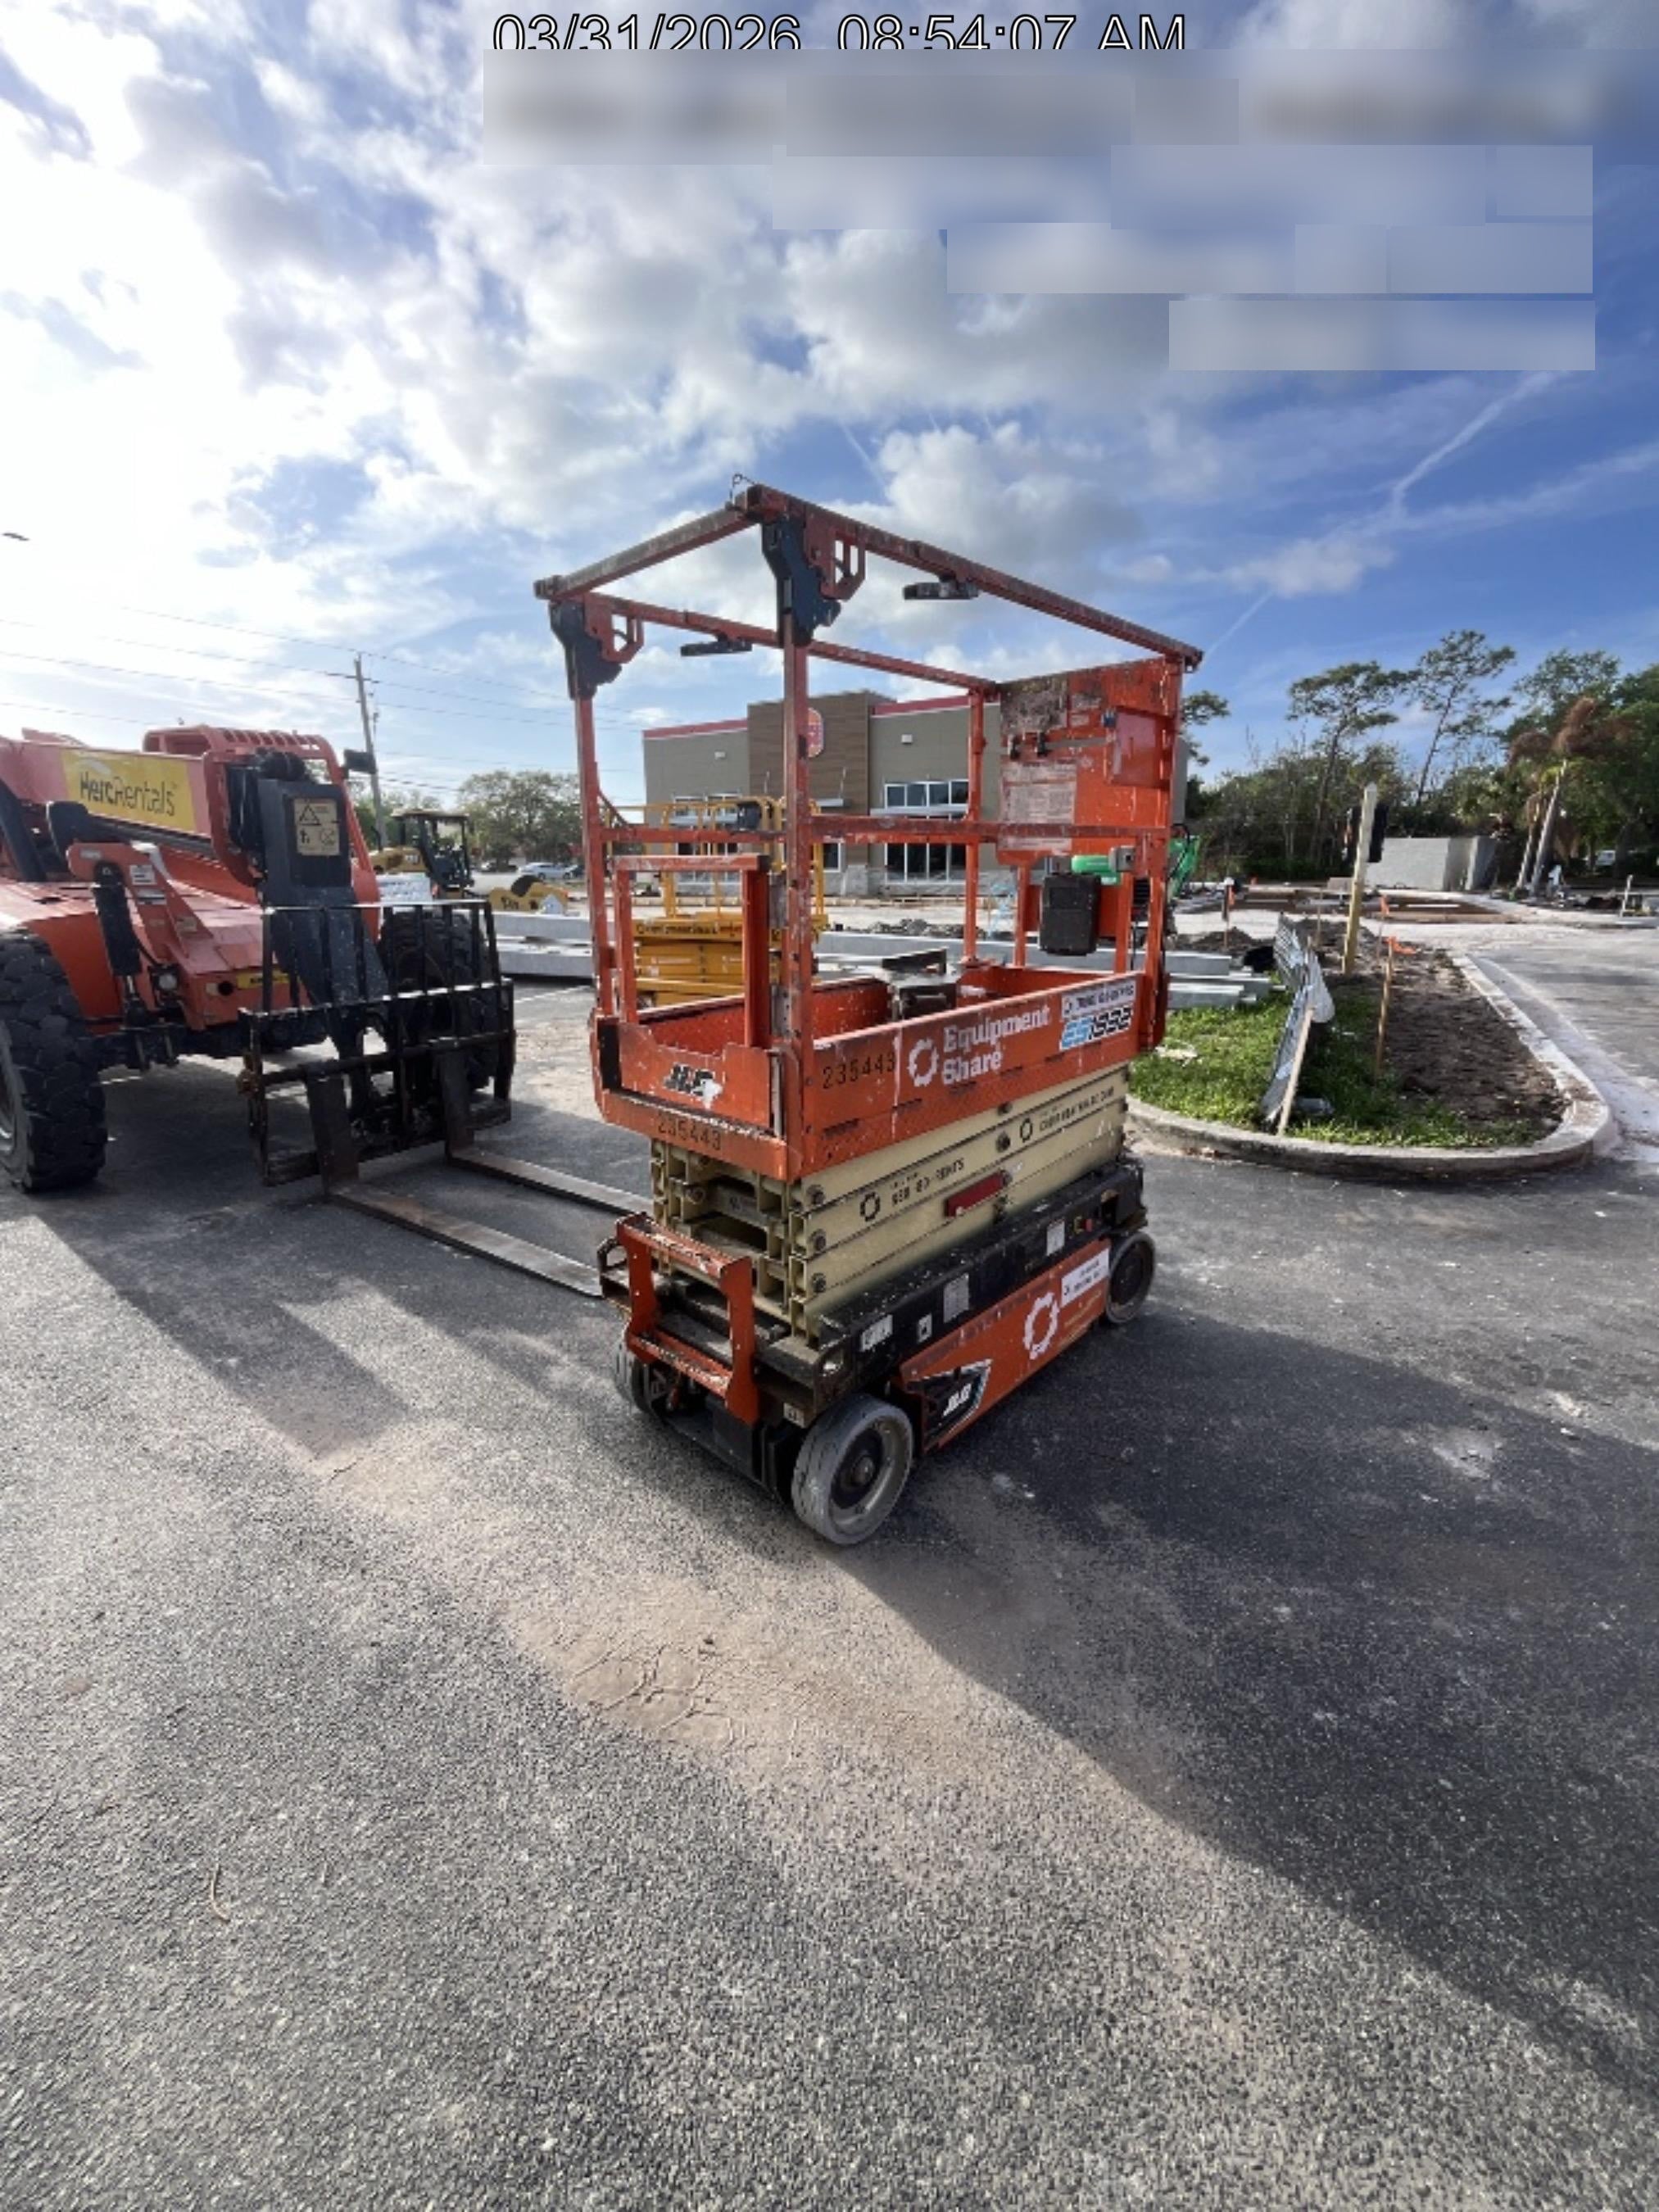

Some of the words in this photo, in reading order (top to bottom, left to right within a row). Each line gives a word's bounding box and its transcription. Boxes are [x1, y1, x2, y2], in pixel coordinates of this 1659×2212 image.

[943, 1004, 1050, 1054] Equipment
[823, 1051, 895, 1089] 235443
[942, 1047, 1002, 1085] Share
[942, 1382, 972, 1417] JLG
